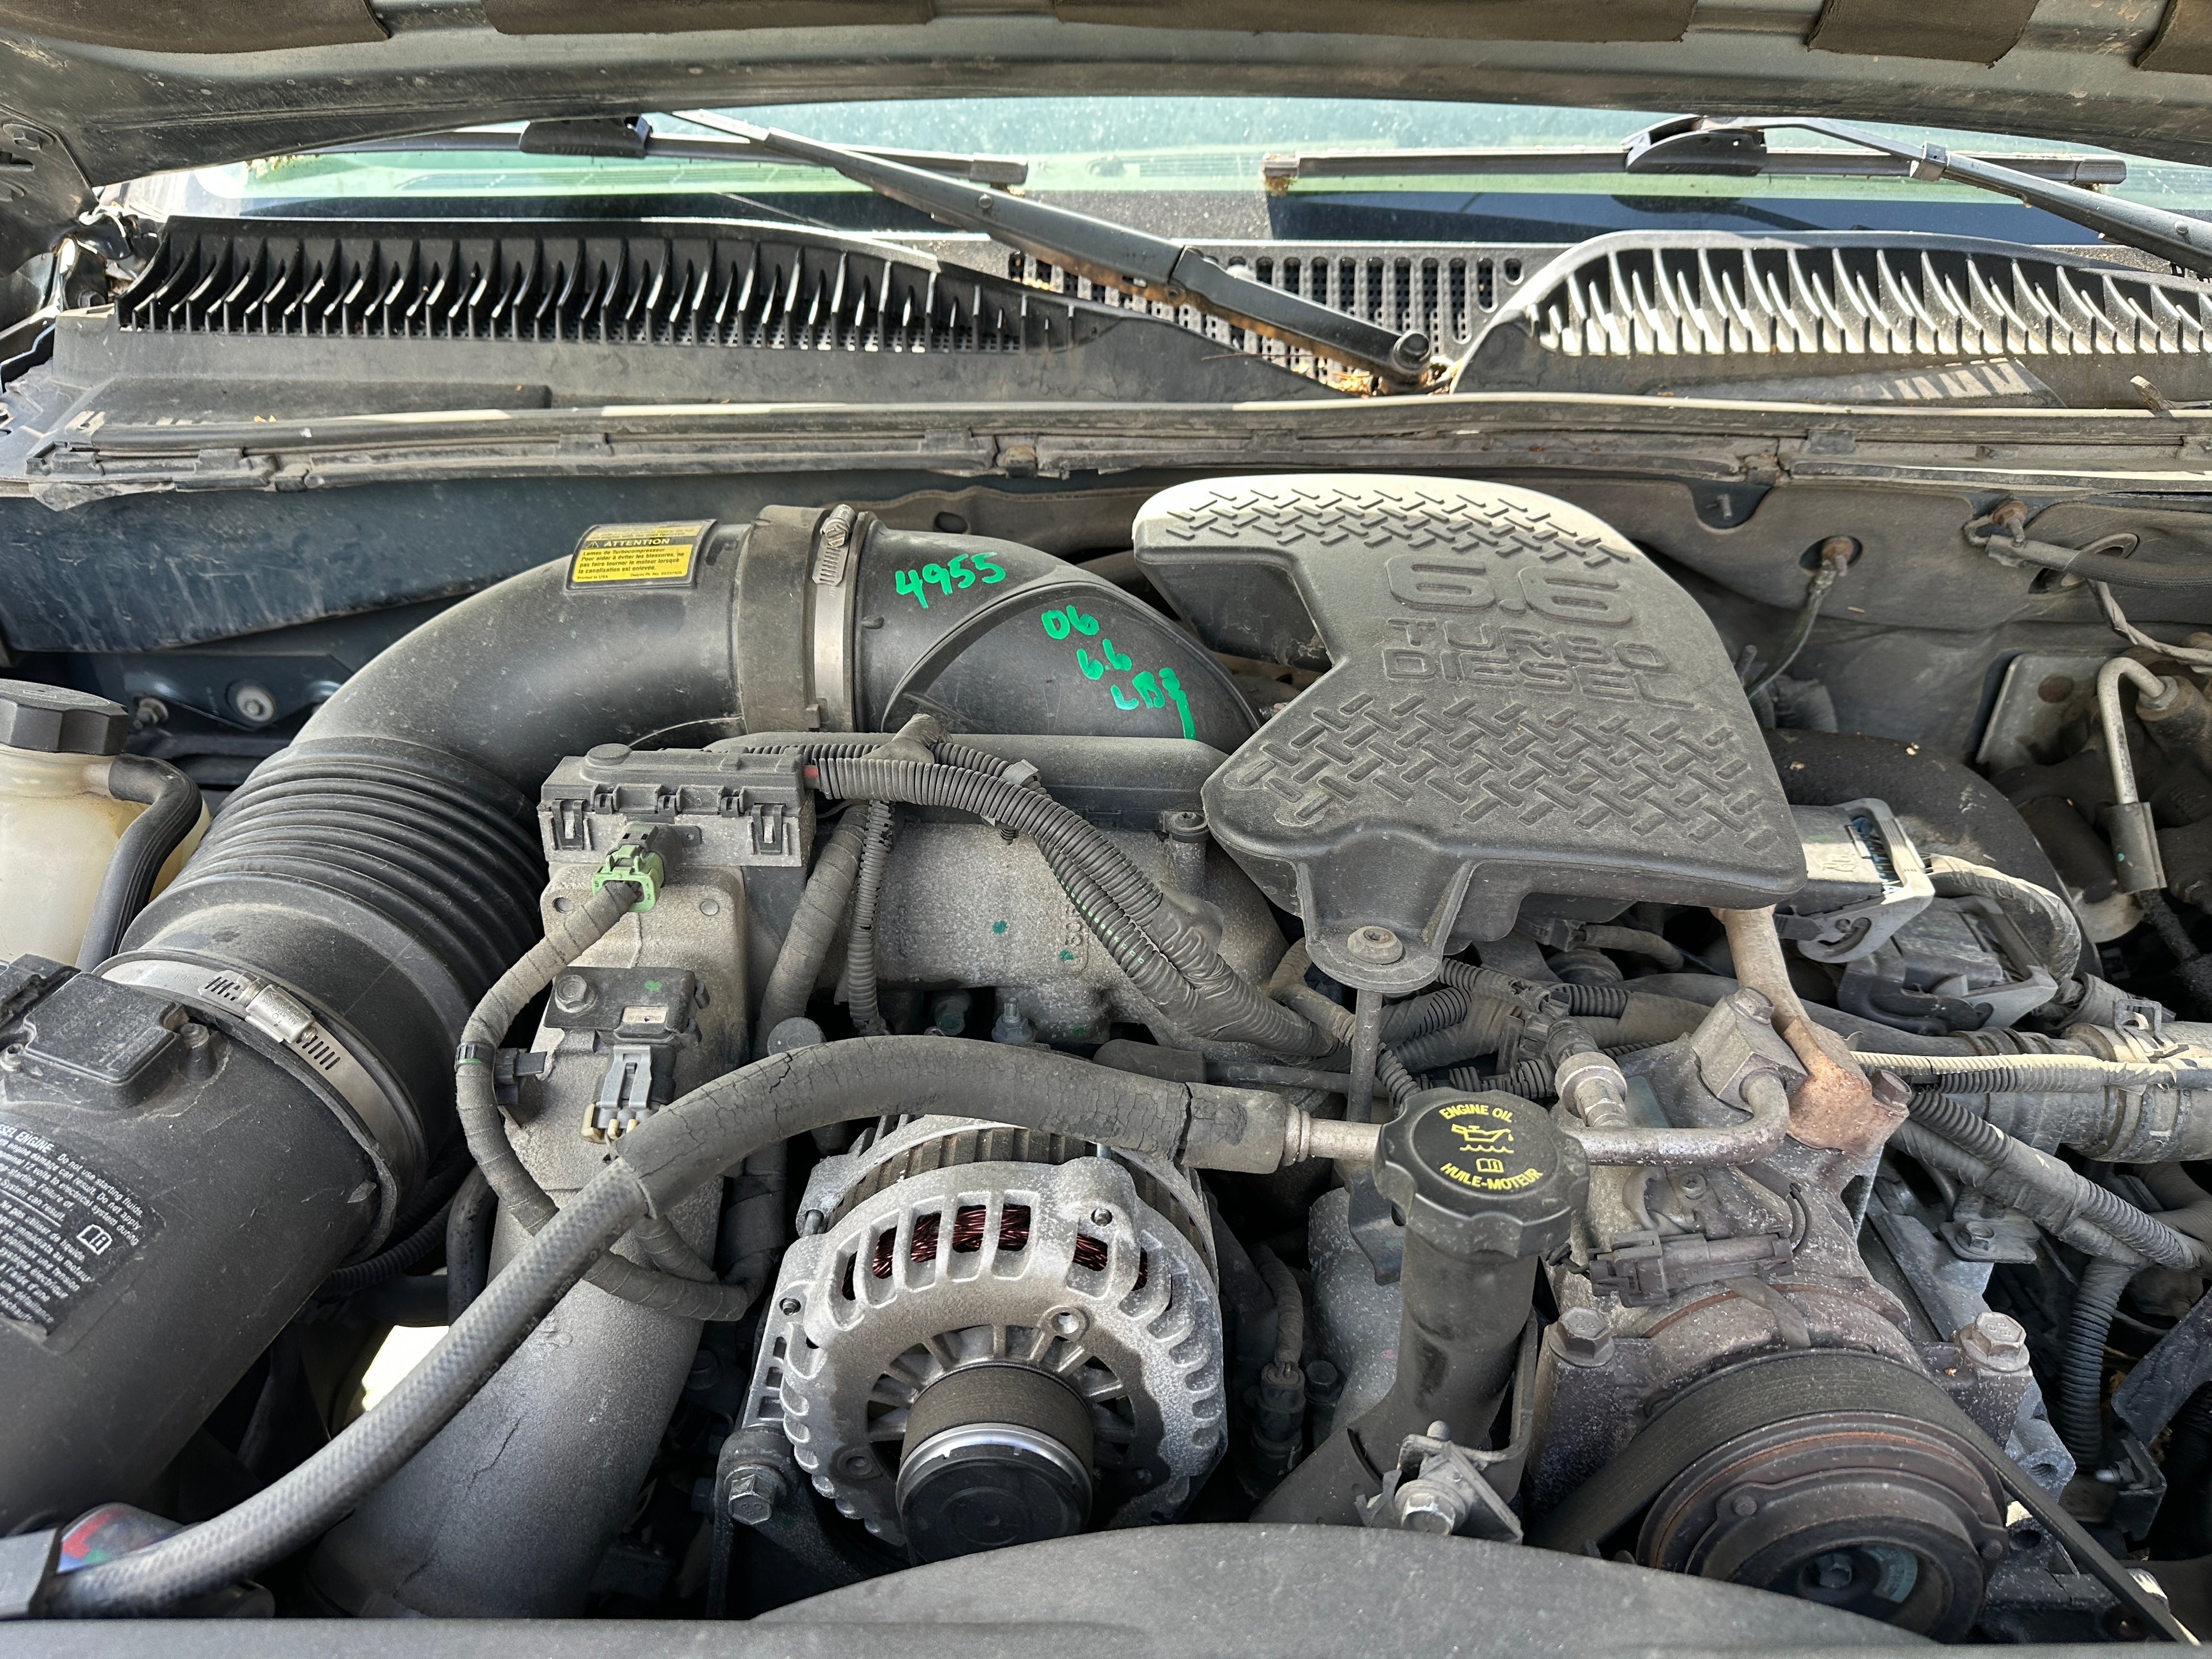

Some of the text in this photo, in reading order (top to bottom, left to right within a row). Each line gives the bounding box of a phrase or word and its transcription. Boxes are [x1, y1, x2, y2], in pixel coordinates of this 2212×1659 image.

[604, 538, 671, 547] ATTENTION
[895, 552, 1006, 608] 4955
[1385, 554, 1634, 628] 6.6
[1387, 618, 1669, 673] TURBO
[1383, 647, 1695, 709] DIESEL
[1438, 1104, 1514, 1123] ENGINE OIL
[1, 1179, 28, 1198] System
[27, 1194, 43, 1206] can
[7, 1143, 32, 1157] engine
[30, 1153, 59, 1171] damage
[58, 1168, 74, 1180] can
[97, 1192, 108, 1204] Do
[108, 1202, 123, 1214] not
[120, 1211, 142, 1230] apply
[14, 1130, 55, 1153] ENGINE
[58, 1153, 69, 1164] Do
[68, 1161, 84, 1172] not
[81, 1169, 96, 1180] use
[94, 1178, 124, 1201] starting
[122, 1197, 143, 1218] fluids.
[37, 1183, 64, 1203] Failure
[1440, 1162, 1544, 1190] HUILE-MOTEUR
[1, 1200, 12, 1210] Ne
[9, 1207, 26, 1219] pas
[25, 1215, 51, 1235] utiliser
[22, 1161, 36, 1171] 12
[33, 1166, 52, 1181] volts
[50, 1175, 60, 1185] to
[59, 1183, 94, 1207] electrical
[91, 1205, 118, 1226] system
[116, 1224, 139, 1247] during
[2, 1233, 80, 1291] appliquer une tension
[63, 1259, 91, 1282] moteur
[14, 1291, 55, 1323] défaillance
